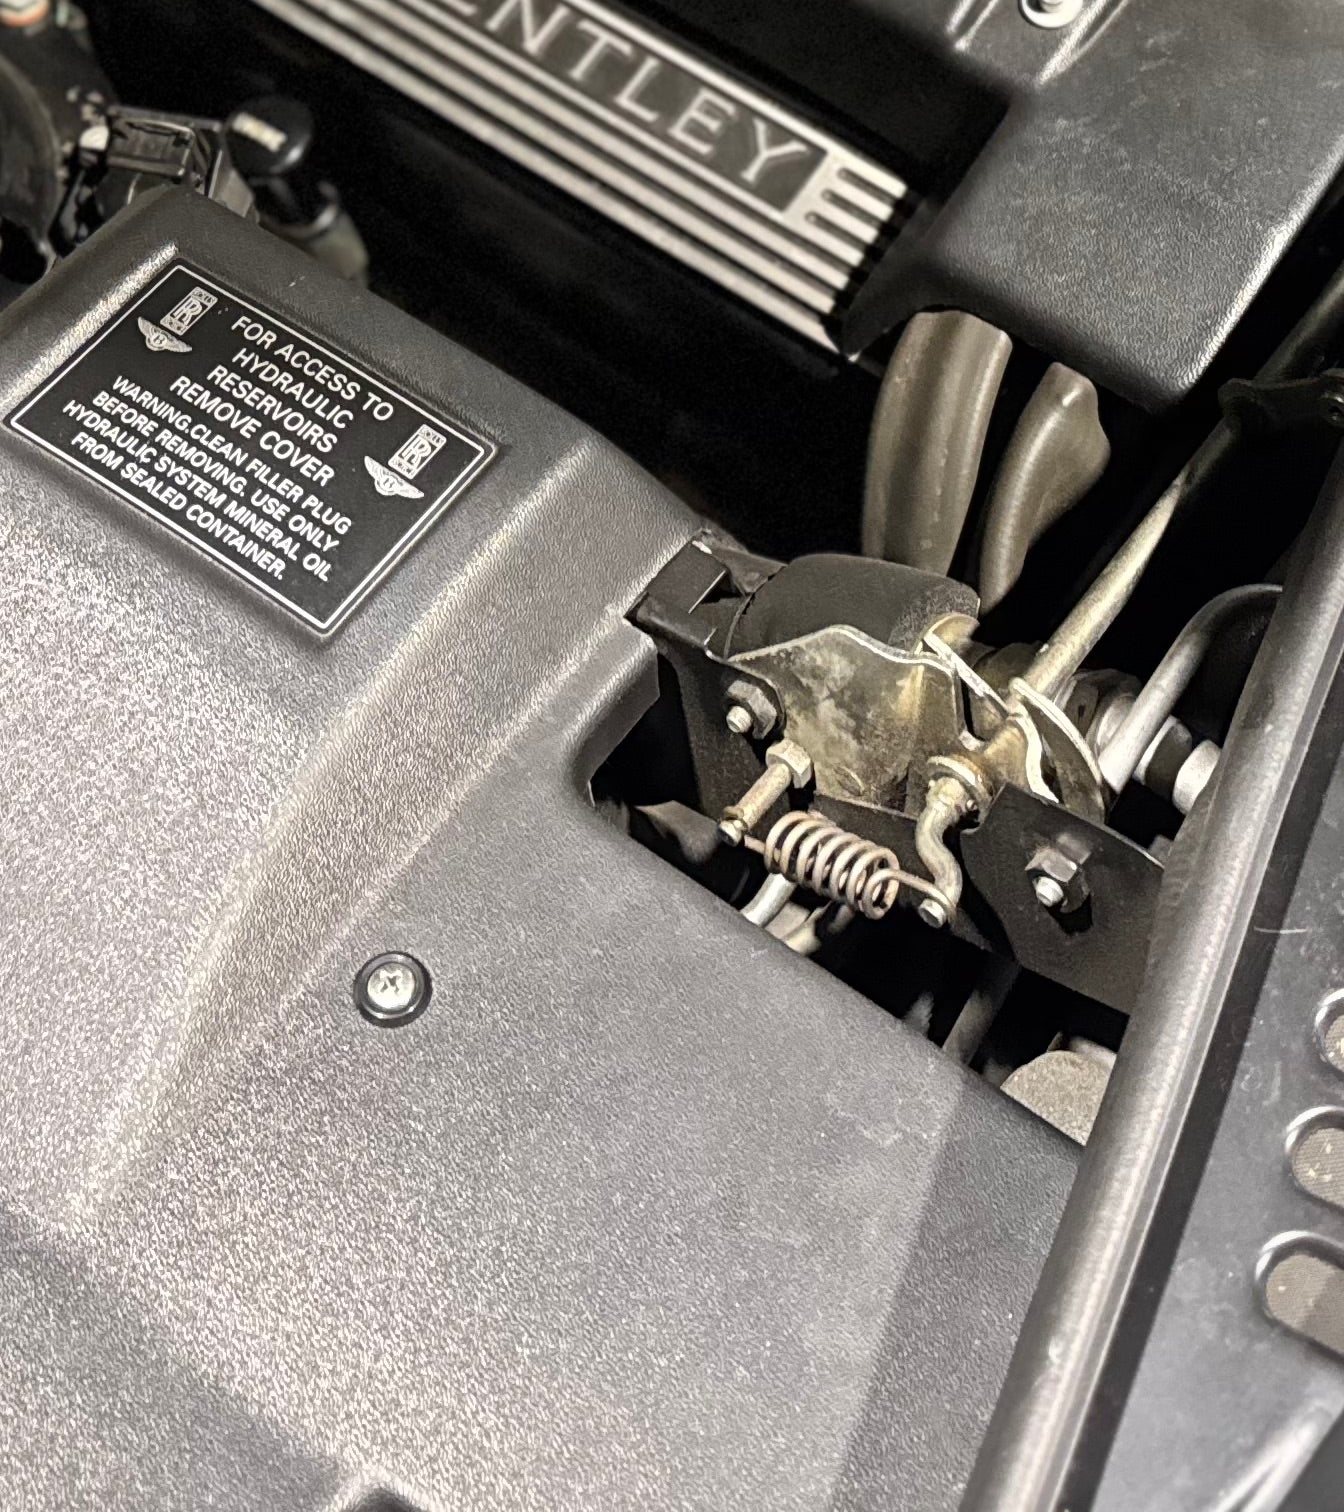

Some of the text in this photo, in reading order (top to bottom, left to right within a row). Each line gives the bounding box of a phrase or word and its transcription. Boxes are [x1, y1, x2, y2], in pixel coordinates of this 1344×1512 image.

[207, 364, 338, 453] RESERVOIRS
[231, 315, 394, 421] FOR ACCESS TO
[231, 348, 354, 429] HYDRAULIC
[92, 390, 340, 552] BEFORE REMOVING. USE ONLY
[169, 375, 335, 487] REMOVE COVER
[62, 399, 332, 582] HYDRAULIC SYSTEM MINERAL OIL
[70, 431, 286, 580] FROM SEALED CONTAINER.
[245, 458, 304, 503] FILLER
[301, 494, 352, 535] PLUG
